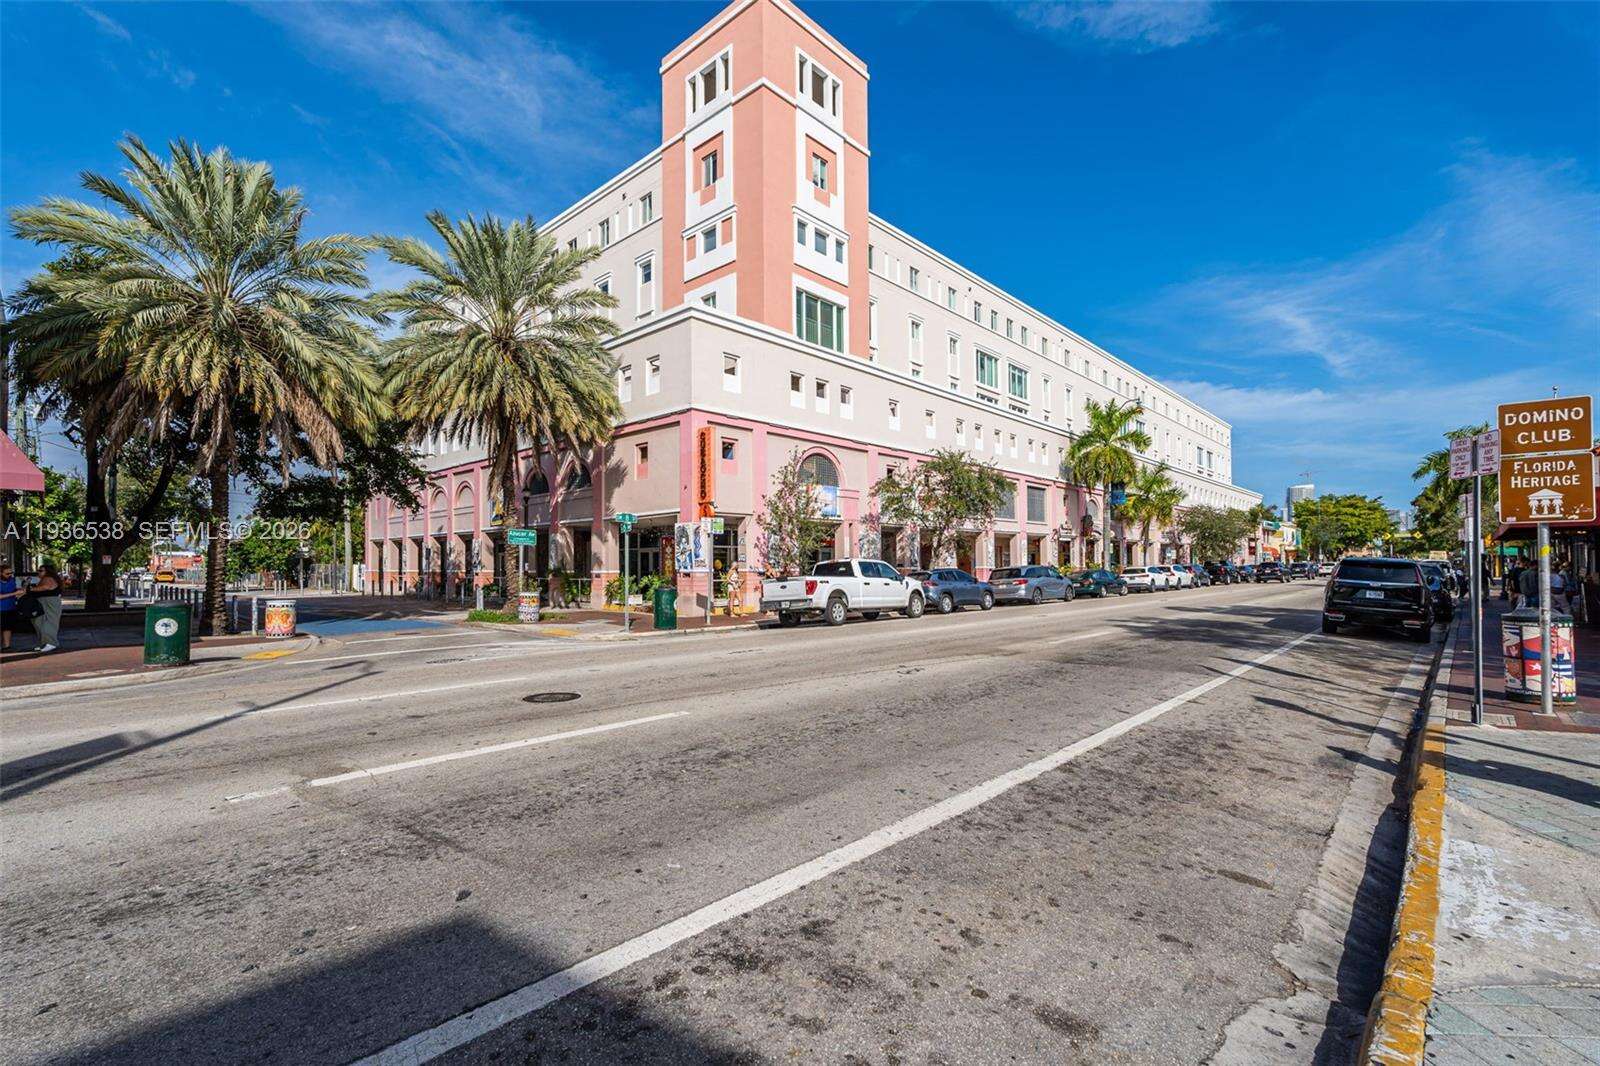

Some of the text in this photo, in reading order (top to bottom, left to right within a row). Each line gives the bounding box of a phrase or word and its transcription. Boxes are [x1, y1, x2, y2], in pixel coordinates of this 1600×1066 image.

[1504, 407, 1584, 426] DOMINO
[1517, 428, 1572, 445] CLUB
[1514, 459, 1577, 474] FLORIDA
[1511, 474, 1581, 489] HERITAGE
